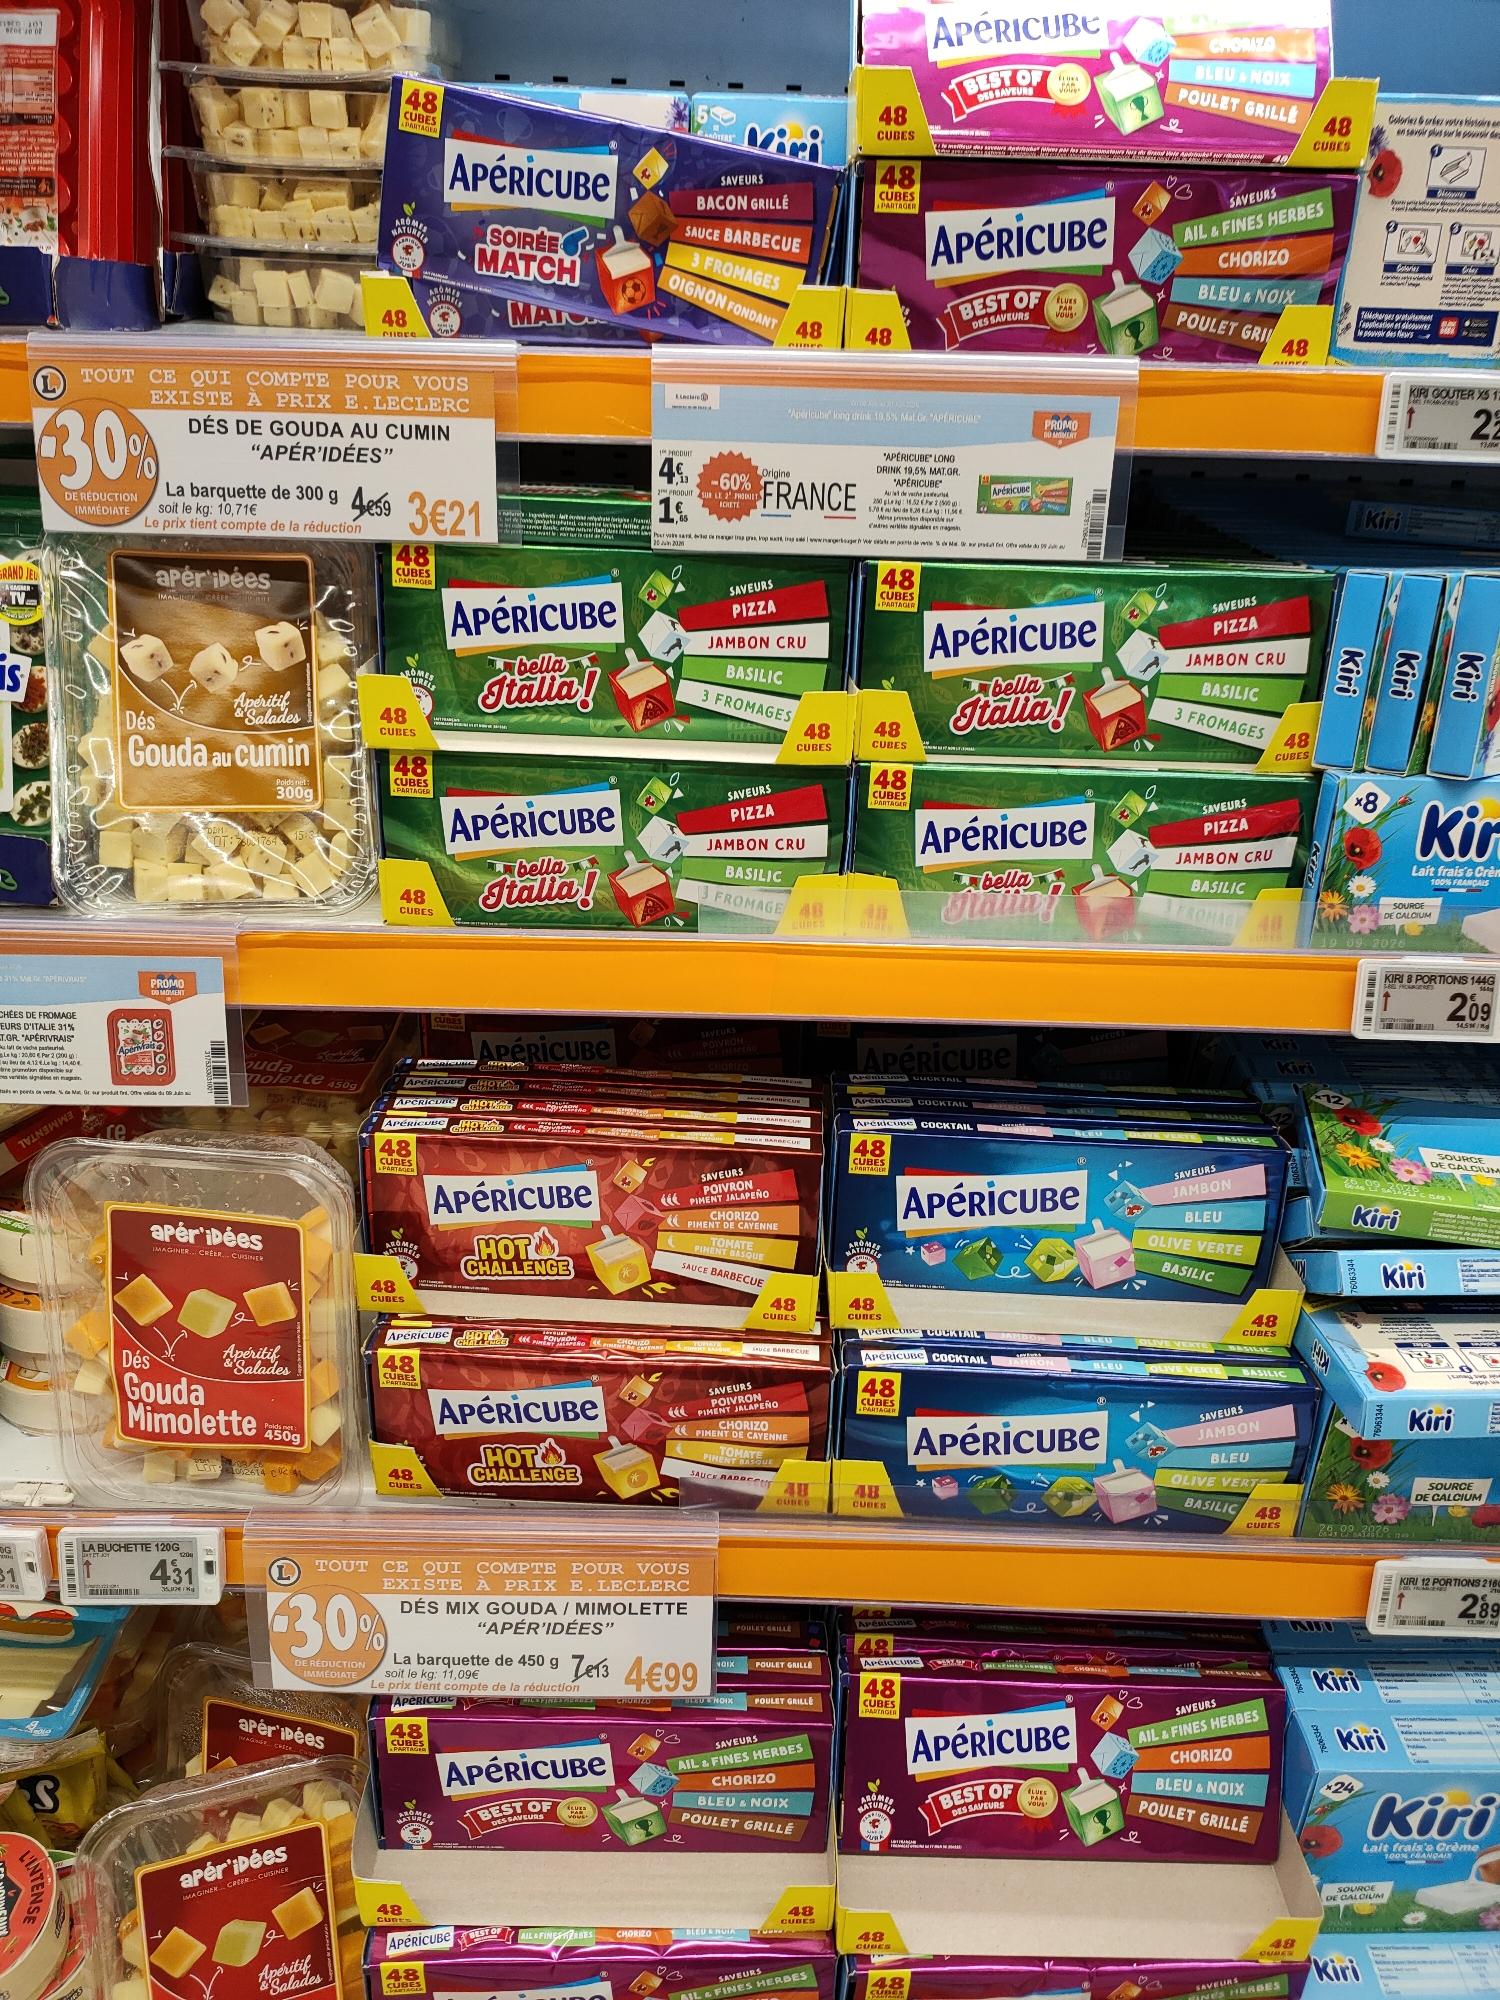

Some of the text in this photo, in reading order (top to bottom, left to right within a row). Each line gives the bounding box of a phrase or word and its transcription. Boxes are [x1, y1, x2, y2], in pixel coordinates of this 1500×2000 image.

[404, 89, 438, 114] 48
[403, 111, 438, 128] CUBES
[696, 194, 789, 211] BACON GRILLÉ
[1183, 203, 1324, 244] AIL & FINES HERBES
[489, 229, 560, 253] SOIRÉE
[685, 225, 801, 253] SAUCE BARBECUE
[476, 247, 578, 284] MATCH
[1218, 249, 1290, 269] CHORIZO
[691, 252, 780, 291] 3 FROMAGES
[668, 275, 778, 329] OIGNON FONDANT
[959, 292, 1041, 318] BEST OF
[81, 368, 469, 392] TOUT CE QUI COMPTE POUR VOUS
[151, 389, 470, 413] EXISTE À PRIX E.LECLERC
[1409, 388, 1429, 398] KIRI
[1432, 388, 1475, 399] GOUTER
[189, 415, 450, 441] DÉS DE GOUDA AU CUMIN
[1044, 419, 1078, 432] PROMO
[41, 408, 156, 490] -30%
[934, 454, 955, 463] LONG
[762, 468, 791, 479] Origine
[876, 466, 901, 475] DRINK
[711, 473, 752, 491] -60%
[65, 490, 138, 502] DE RÉDUCTION
[166, 482, 338, 505] La barquette de 300 g
[763, 481, 857, 512] FRANCE
[75, 504, 130, 516] IMMÉDIATE
[159, 502, 257, 517] soit le kg: 10,71€
[408, 491, 481, 537] 3€21
[144, 517, 362, 534] Le prix tient compte de la réduction
[881, 568, 915, 590] 48
[880, 590, 915, 603] CUBES
[732, 600, 776, 619] PIZZA
[708, 635, 806, 650] JAMBON CRU
[517, 654, 567, 675] bella
[1334, 647, 1366, 698] Kiri
[234, 691, 291, 711] Apéritif
[1201, 682, 1260, 703] BASILIC
[126, 711, 155, 731] Dés
[245, 709, 301, 726] Salades
[1174, 708, 1265, 741] 3 FROMAGES
[128, 736, 310, 768] Gouda au cumin
[276, 786, 314, 802] 300g
[1453, 879, 1490, 887] FRANÇAIS
[151, 979, 185, 989] PROMO
[1384, 974, 1496, 986] KIRI 8 PORTIONS 144G
[18, 1110, 75, 1149] EMMENTAL
[920, 1120, 974, 1131] COCKTAIL
[703, 1179, 754, 1195] POIVRON
[710, 1210, 760, 1222] CHORIZO
[1184, 1210, 1222, 1224] BLEU
[478, 1238, 531, 1260] HOT
[465, 1258, 570, 1277] CHALLENGE
[1381, 1262, 1426, 1290] Kiri
[124, 1373, 205, 1405] Gouda
[128, 1402, 257, 1437] Mimolette
[264, 1429, 301, 1445] 450g
[1427, 1482, 1474, 1491] SOURCE
[1415, 1493, 1483, 1502] DE CALCIUM
[82, 1543, 180, 1552] LA BUCHETTE 120G
[1400, 1577, 1480, 1586] KIRI 12 PORTIONS
[400, 1598, 439, 1614] DÉS
[446, 1601, 480, 1615] MIX
[486, 1601, 557, 1616] GOUDA
[576, 1602, 688, 1616] MIMOLETTE
[273, 1593, 385, 1658] -30%
[624, 1656, 698, 1692] 4€99
[1138, 1800, 1249, 1833] POULET GRILLÉ
[1370, 1792, 1499, 1840] Kiri
[18, 1849, 45, 1926] L'INTENSE
